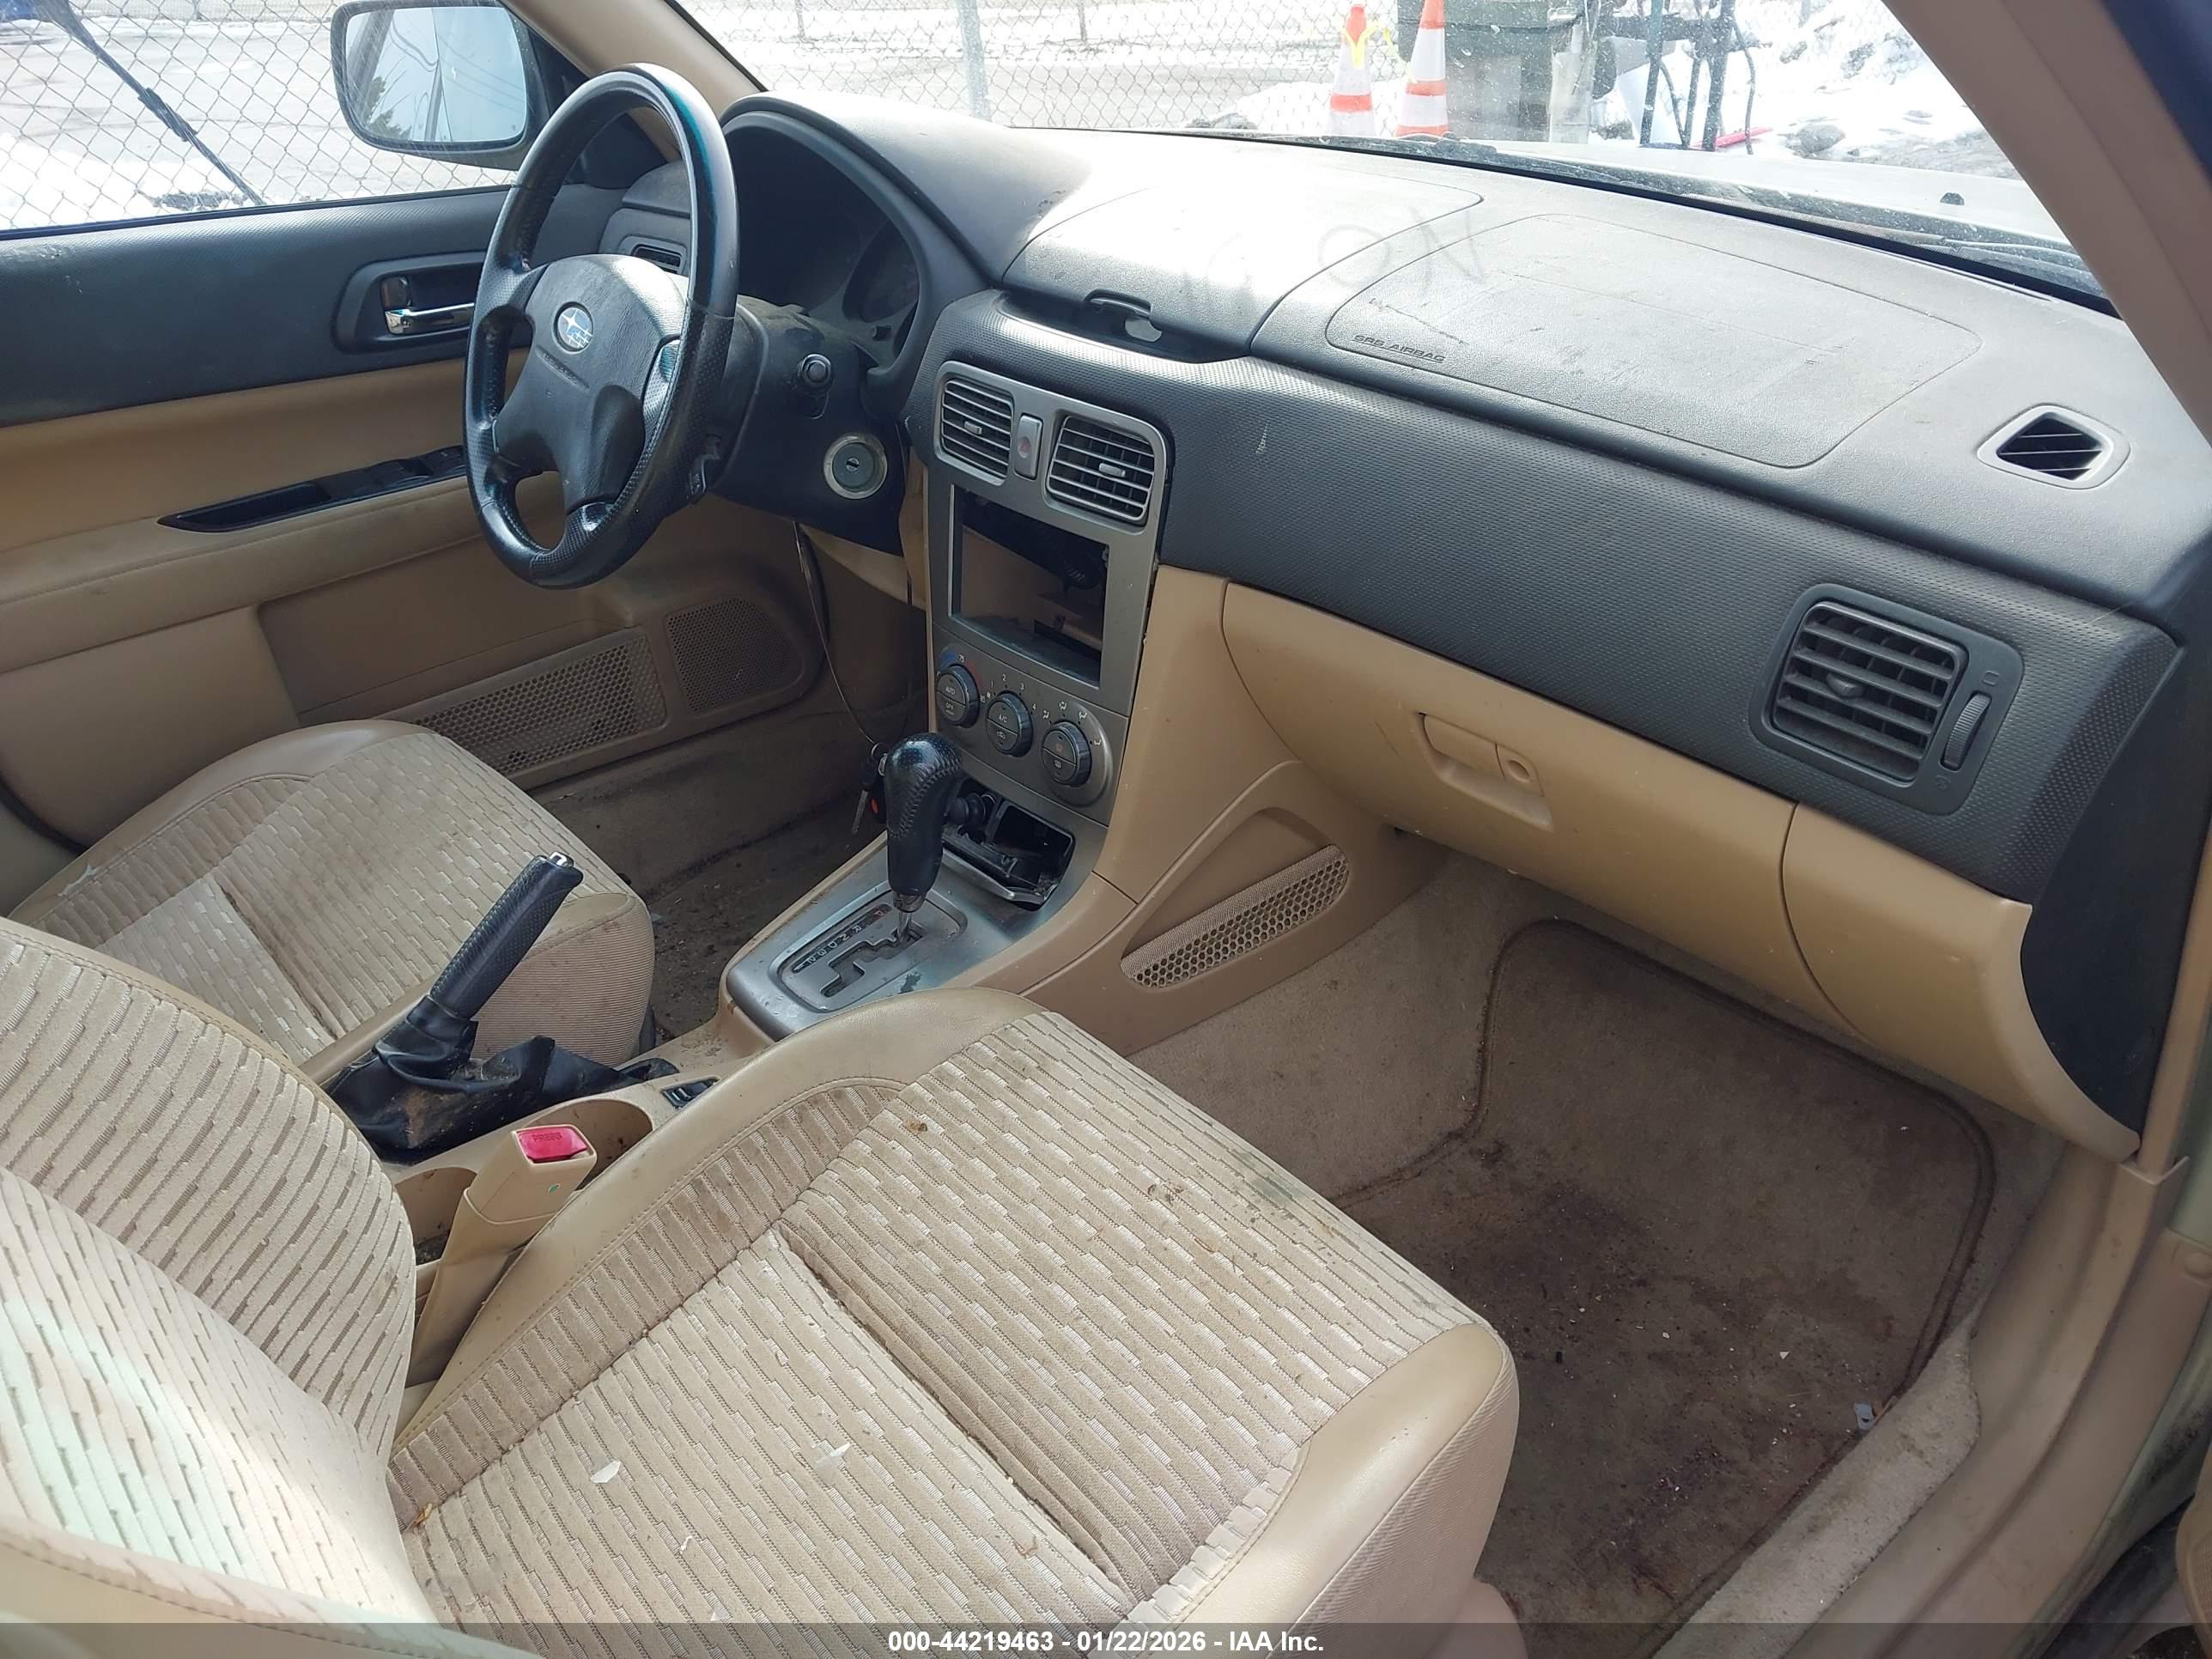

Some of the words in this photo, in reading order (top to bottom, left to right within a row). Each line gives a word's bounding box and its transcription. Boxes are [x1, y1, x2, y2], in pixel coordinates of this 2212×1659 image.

[1352, 335, 1385, 347] SRS
[1389, 343, 1446, 361] AIRBAG
[999, 714, 1008, 723] A/C
[532, 1132, 563, 1142] PRESS
